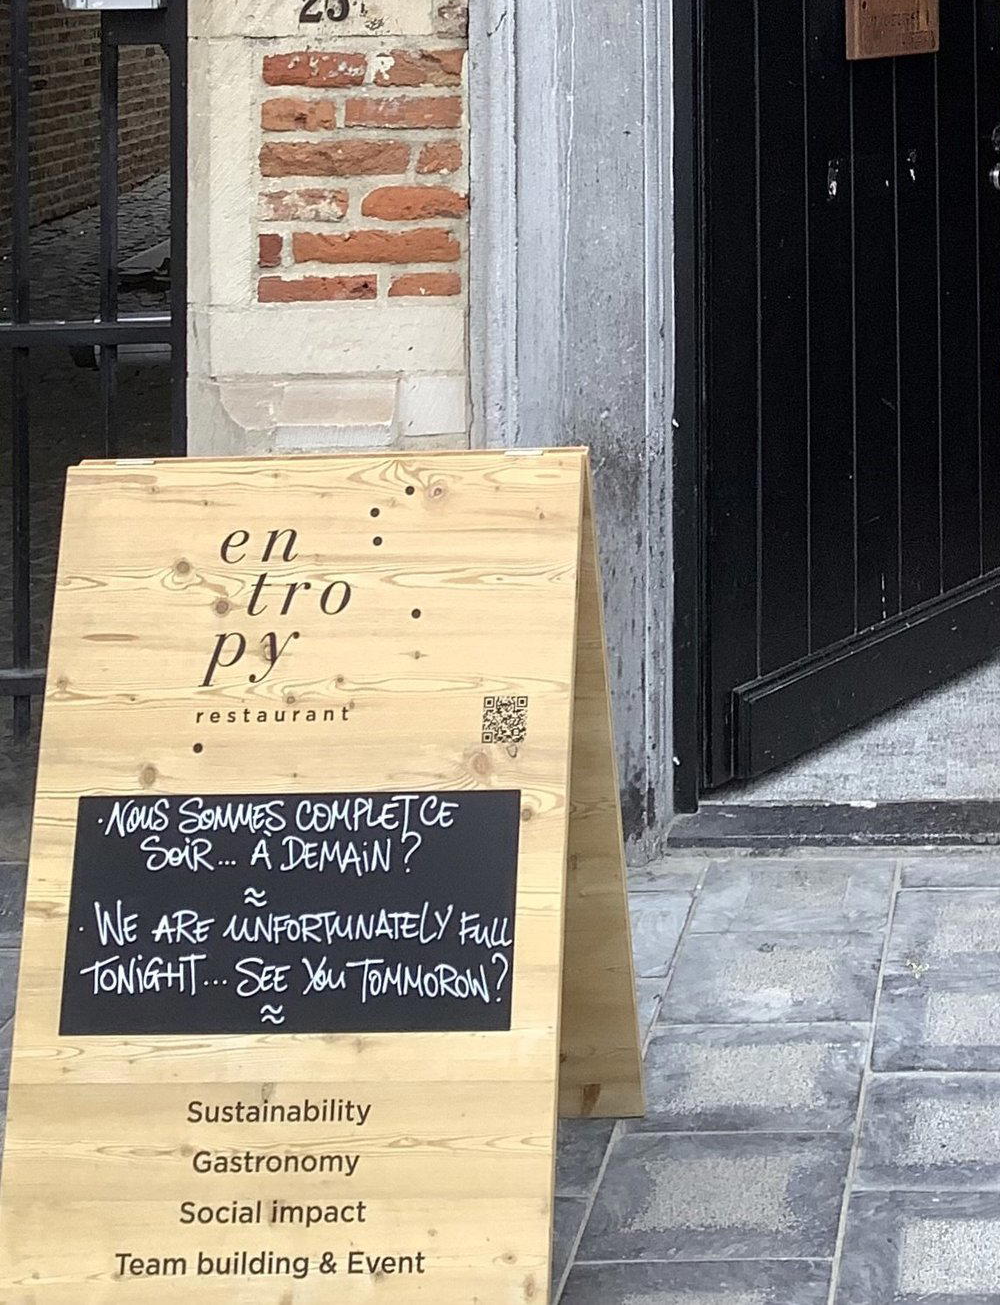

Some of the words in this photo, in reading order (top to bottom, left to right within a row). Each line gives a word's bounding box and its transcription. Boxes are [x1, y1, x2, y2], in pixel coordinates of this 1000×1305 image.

[220, 528, 299, 564] en
[247, 572, 352, 617] tro
[198, 631, 300, 688] py
[195, 706, 350, 724] restaurant
[178, 797, 286, 834] SOMMES
[419, 795, 459, 827] CE
[250, 830, 272, 870] À
[94, 899, 138, 946] WE
[151, 909, 215, 944] ARE
[222, 901, 453, 945] UNFORTUNATELY
[235, 957, 291, 997] SEE
[186, 1099, 372, 1126] Sustainability
[192, 1150, 360, 1176] Gastronomy
[179, 1200, 262, 1224] Social
[271, 1201, 366, 1227] impact
[114, 1252, 187, 1276] Team
[197, 1251, 310, 1279] building
[318, 1252, 337, 1275] &
[347, 1251, 426, 1274] Event
